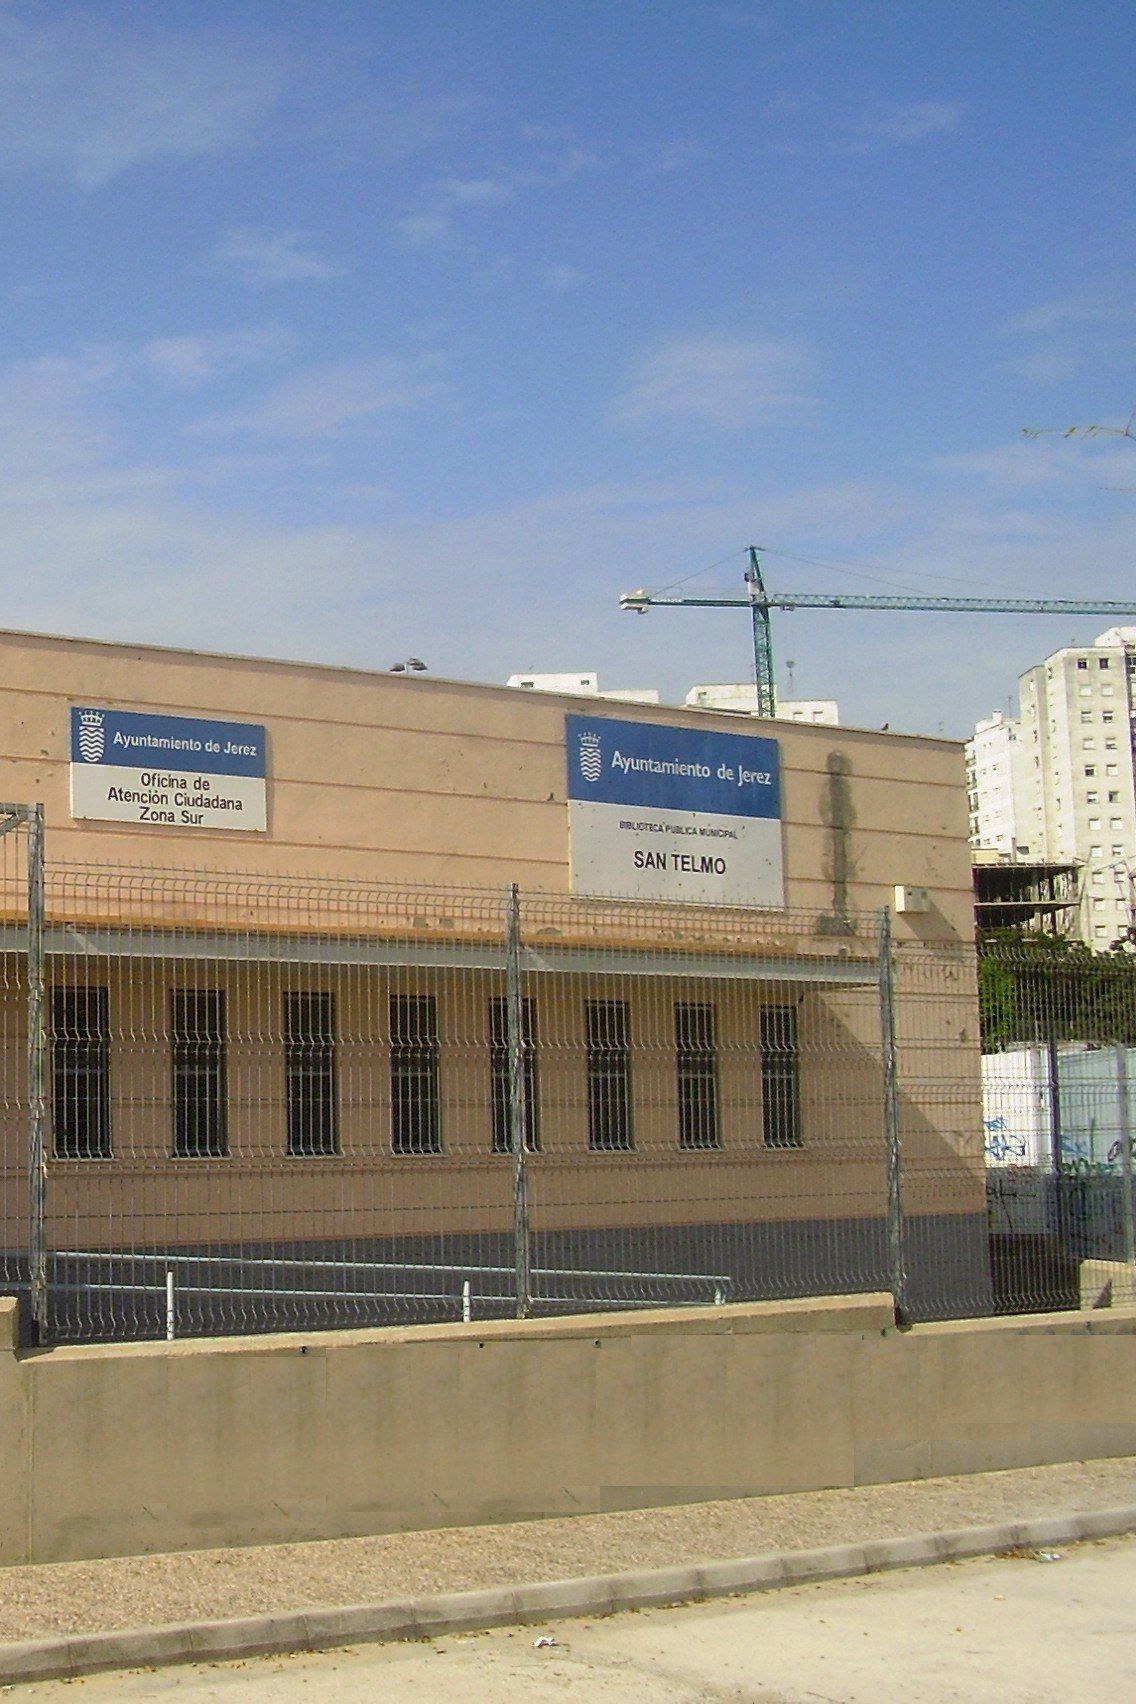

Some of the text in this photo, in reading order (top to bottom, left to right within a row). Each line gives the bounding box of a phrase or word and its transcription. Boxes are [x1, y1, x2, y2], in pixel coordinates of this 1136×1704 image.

[114, 732, 257, 756] Ayuntamiento de Jerez
[611, 751, 771, 786] Ayuntamiento de Jerez
[141, 773, 210, 791] Oficina de
[108, 787, 243, 811] Atención Ciudadana
[139, 806, 204, 825] Zona Sur
[619, 821, 663, 833] BIBLIOTECA
[699, 828, 738, 840] MUNICIPAL
[634, 850, 726, 875] SAN TELMO
